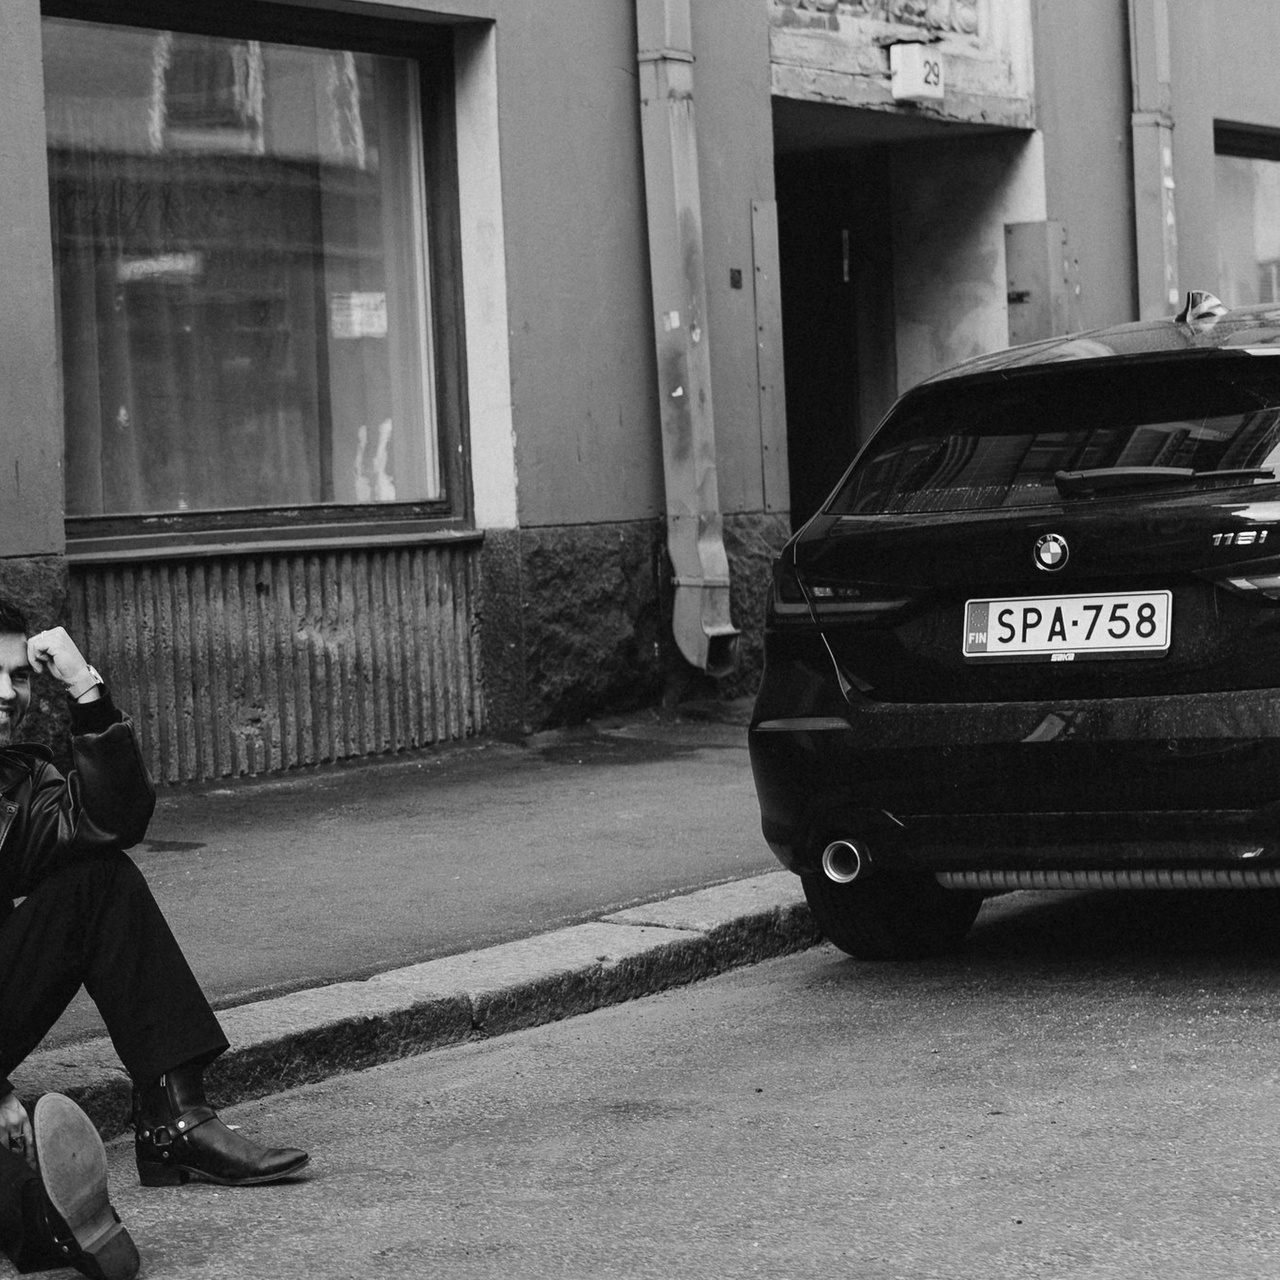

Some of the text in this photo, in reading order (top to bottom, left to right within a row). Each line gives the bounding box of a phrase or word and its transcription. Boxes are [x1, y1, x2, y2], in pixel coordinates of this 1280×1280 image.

[923, 60, 940, 87] 29
[1212, 530, 1269, 546] 118i
[969, 632, 987, 644] FIN
